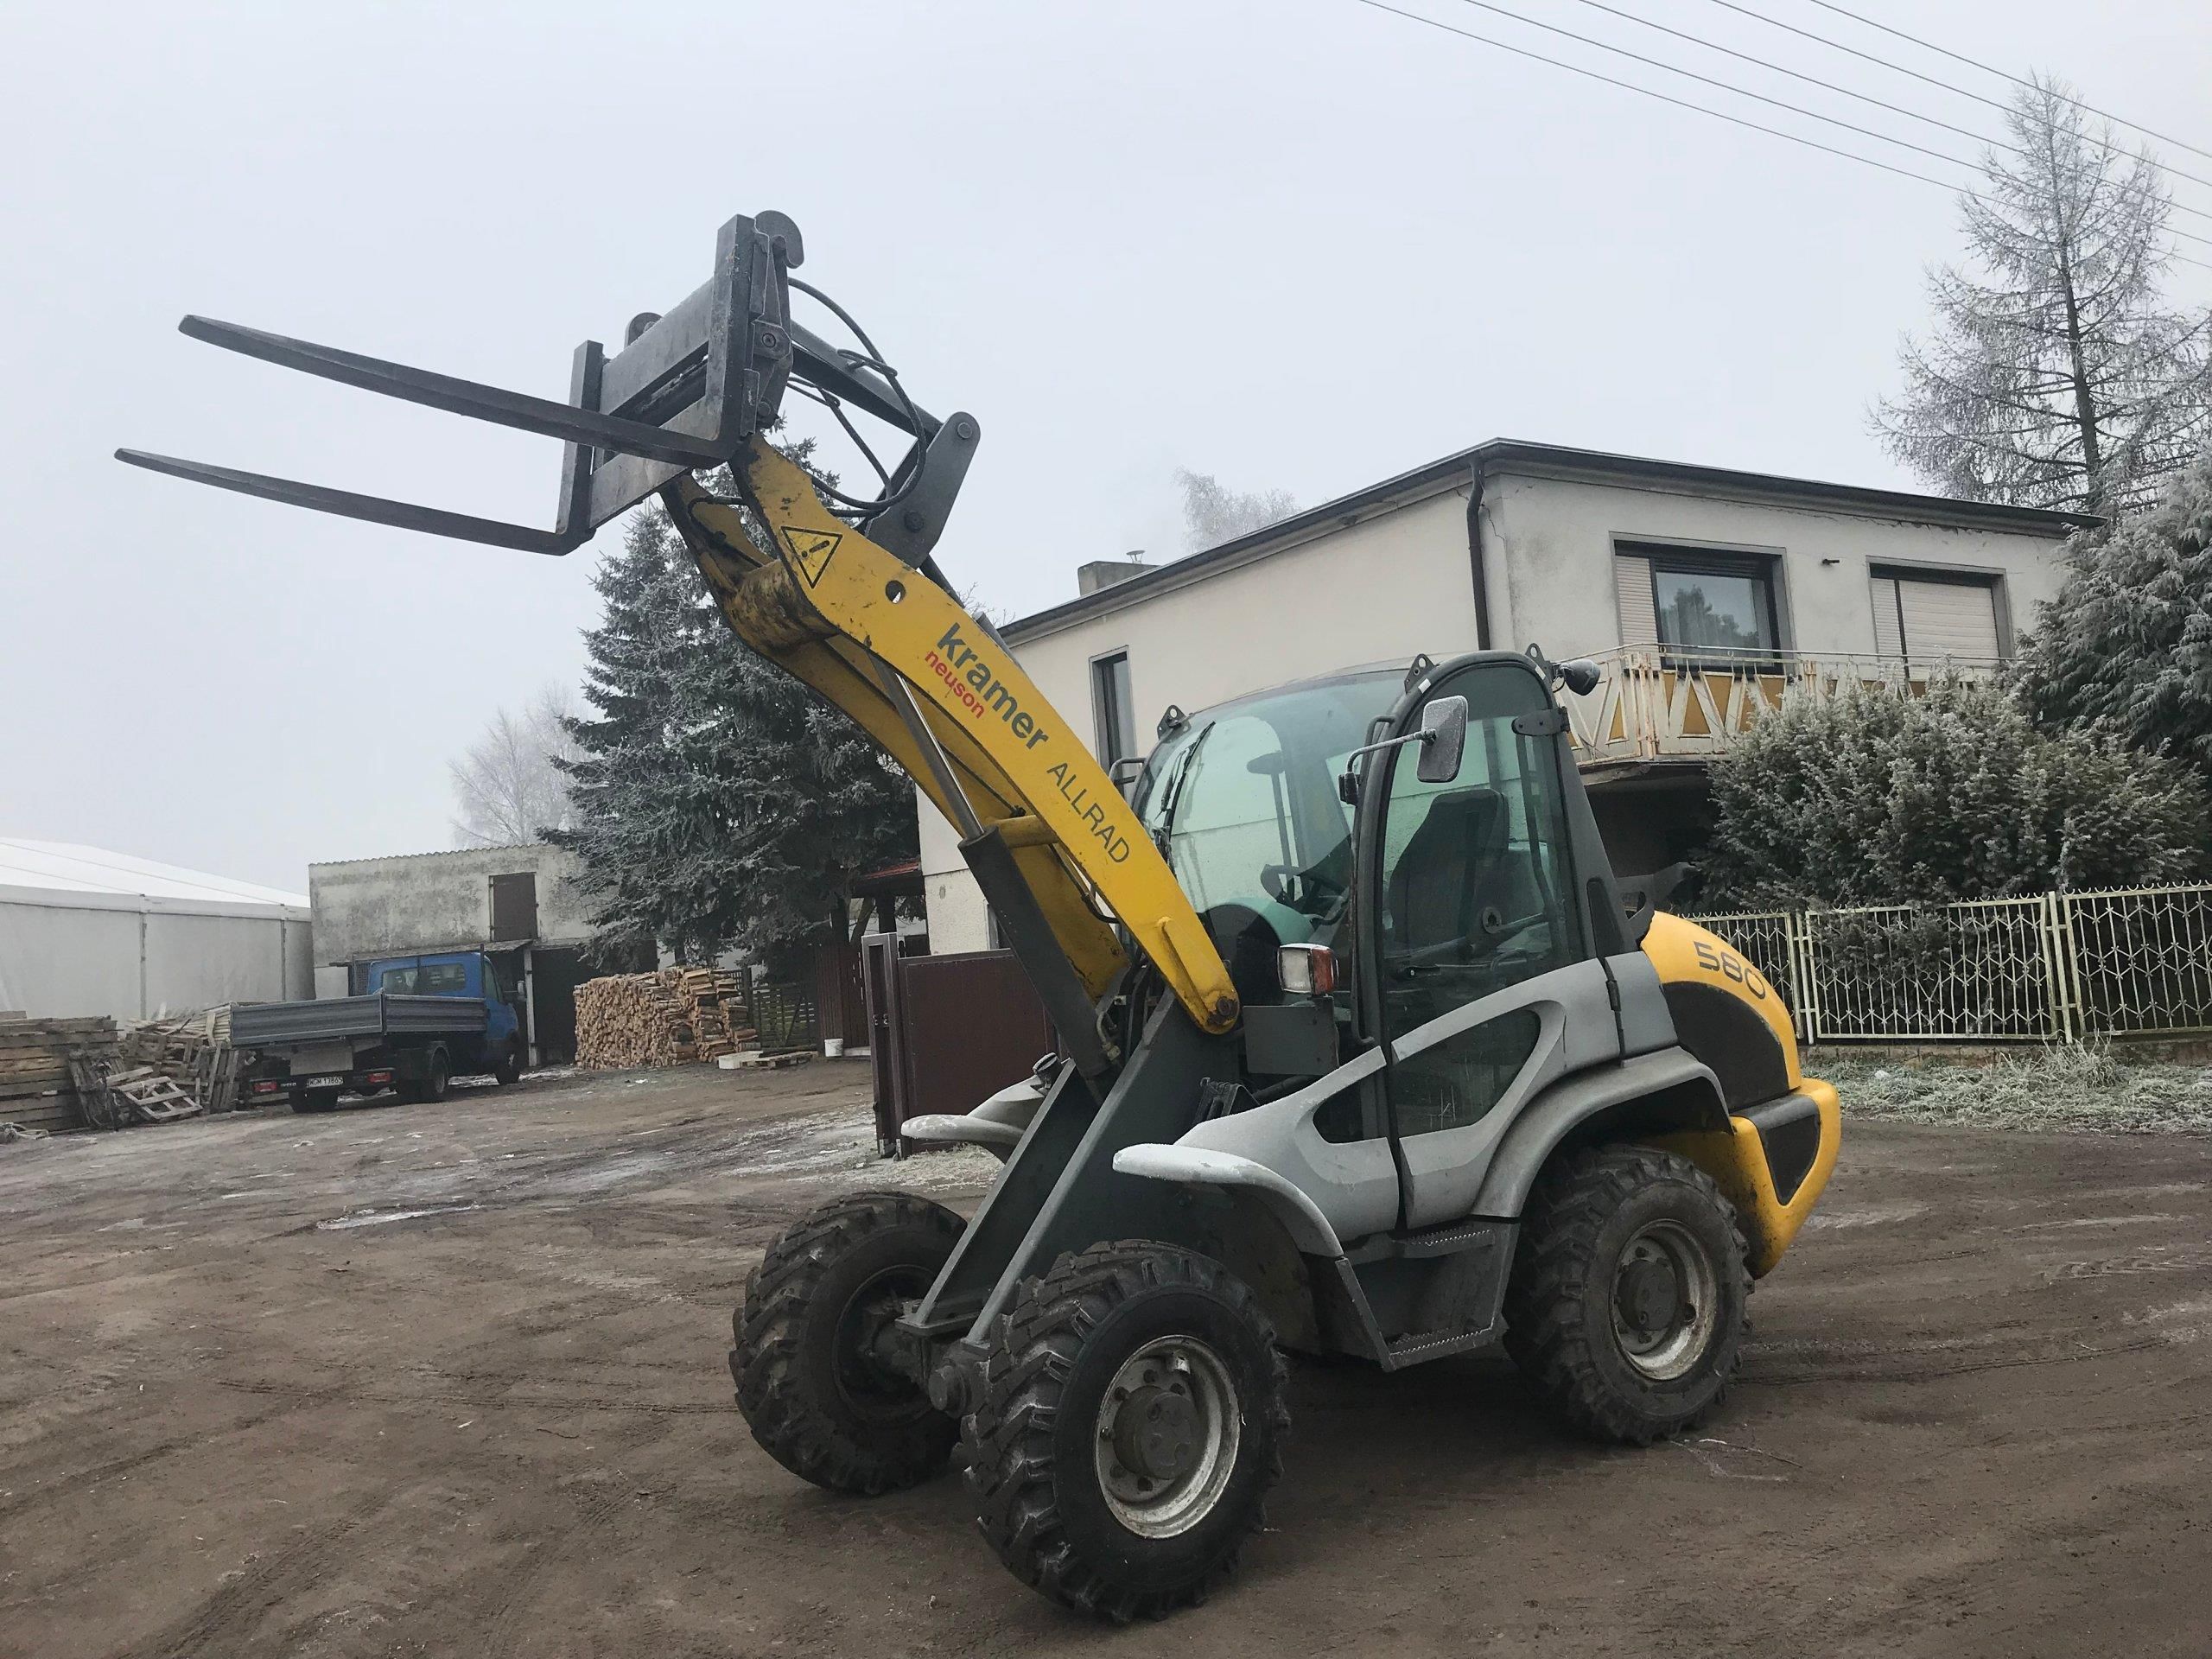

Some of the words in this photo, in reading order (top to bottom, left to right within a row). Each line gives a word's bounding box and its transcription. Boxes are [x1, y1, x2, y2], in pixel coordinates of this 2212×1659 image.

[925, 651, 986, 719] neuson
[937, 623, 1049, 750] kramer
[1046, 762, 1130, 863] ALLRAD
[1694, 941, 1766, 1000] 580
